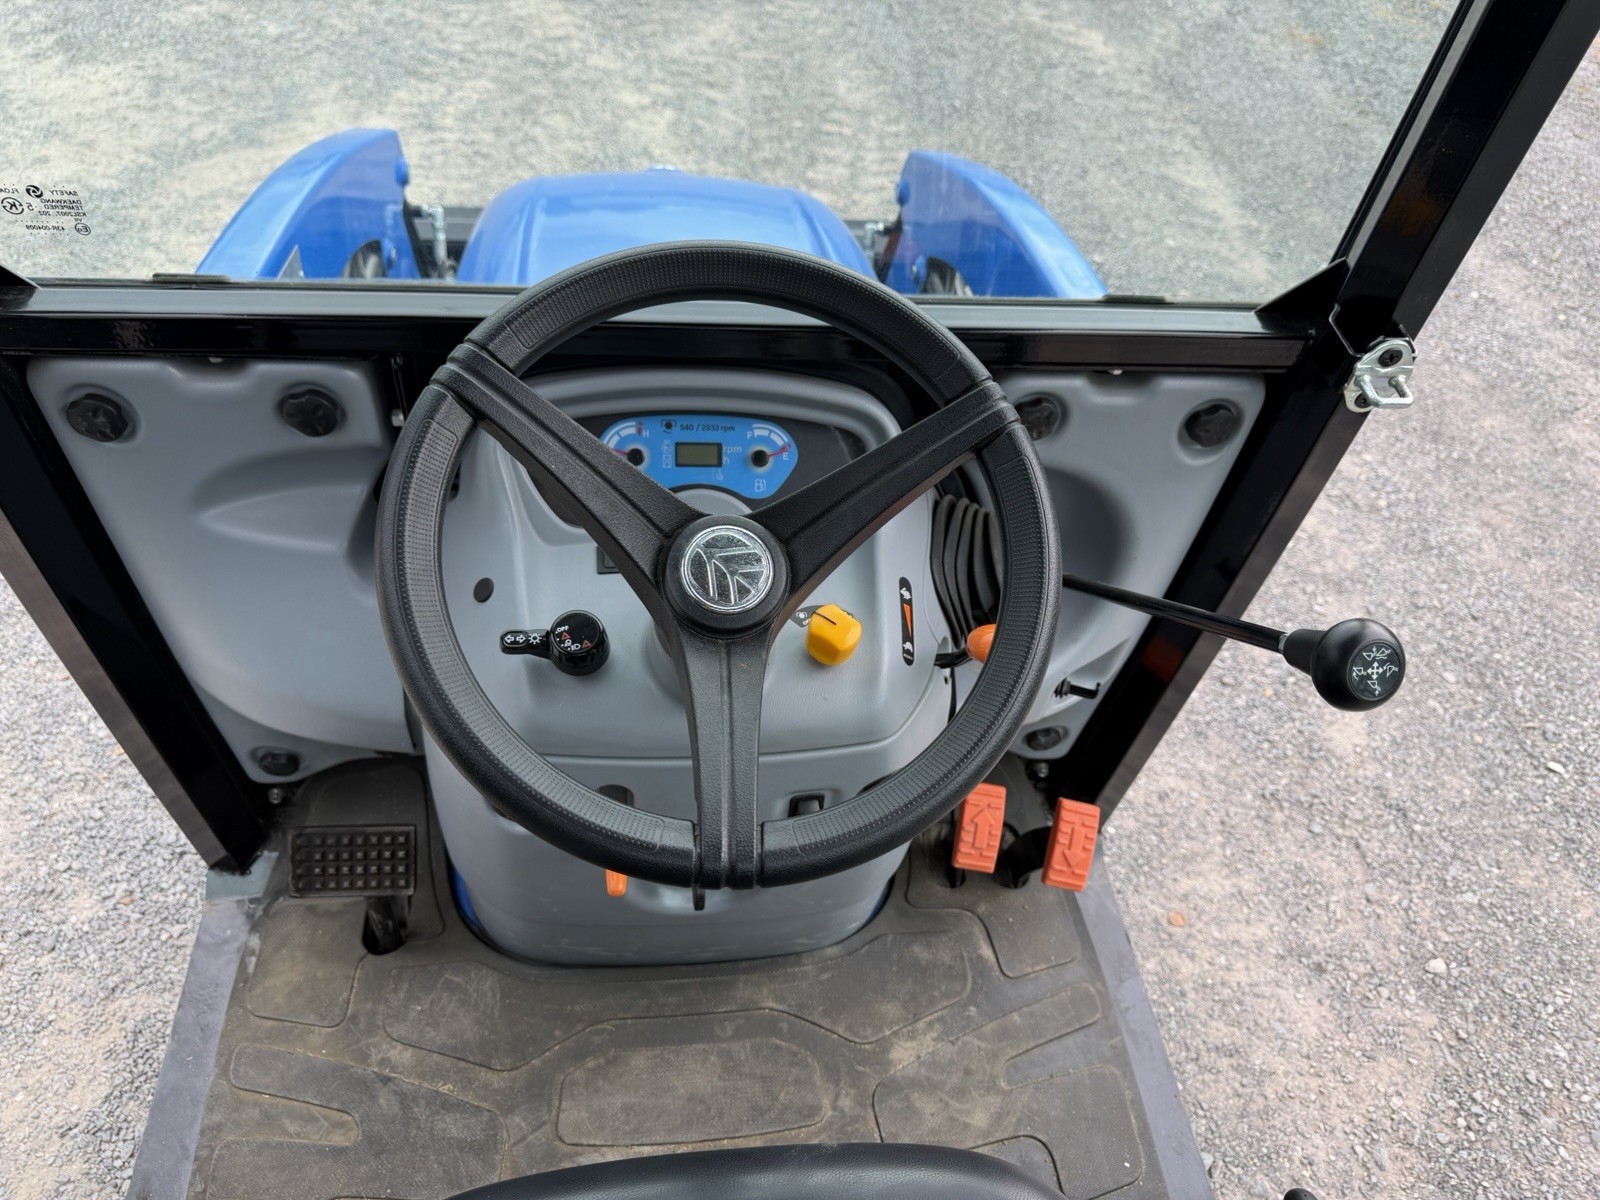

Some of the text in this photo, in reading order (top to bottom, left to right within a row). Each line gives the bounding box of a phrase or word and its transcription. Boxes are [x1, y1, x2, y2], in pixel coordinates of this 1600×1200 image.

[701, 424, 720, 432] 2933
[642, 430, 649, 438] H
[747, 431, 753, 439] F
[723, 446, 742, 454] rpm
[783, 452, 789, 460] E
